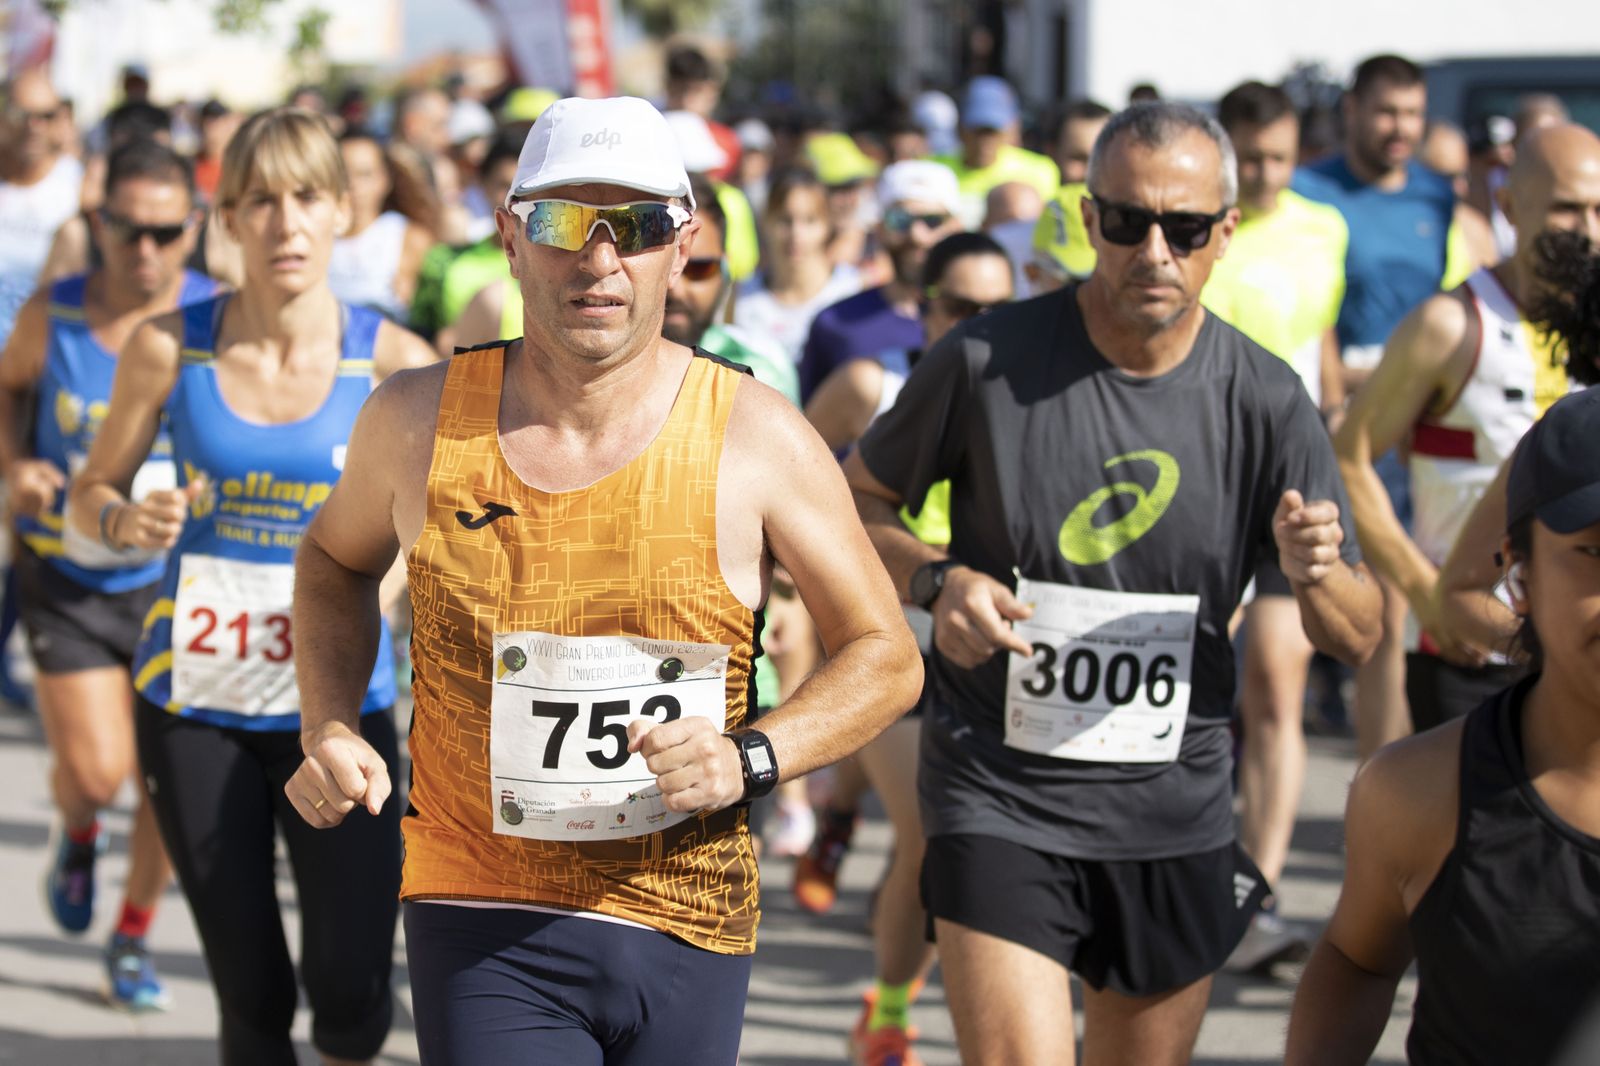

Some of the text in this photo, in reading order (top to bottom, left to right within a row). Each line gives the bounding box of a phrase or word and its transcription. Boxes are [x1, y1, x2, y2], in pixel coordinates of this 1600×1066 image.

[580, 127, 623, 151] edp
[186, 607, 293, 663] 213
[526, 638, 553, 659] XXXVI
[555, 641, 582, 660] GRAN
[586, 643, 621, 660] PREMIO
[625, 643, 639, 657] DE
[641, 641, 673, 655] FONDO
[568, 663, 647, 682] UNIVERSO LORCA
[1021, 642, 1178, 708] 3006
